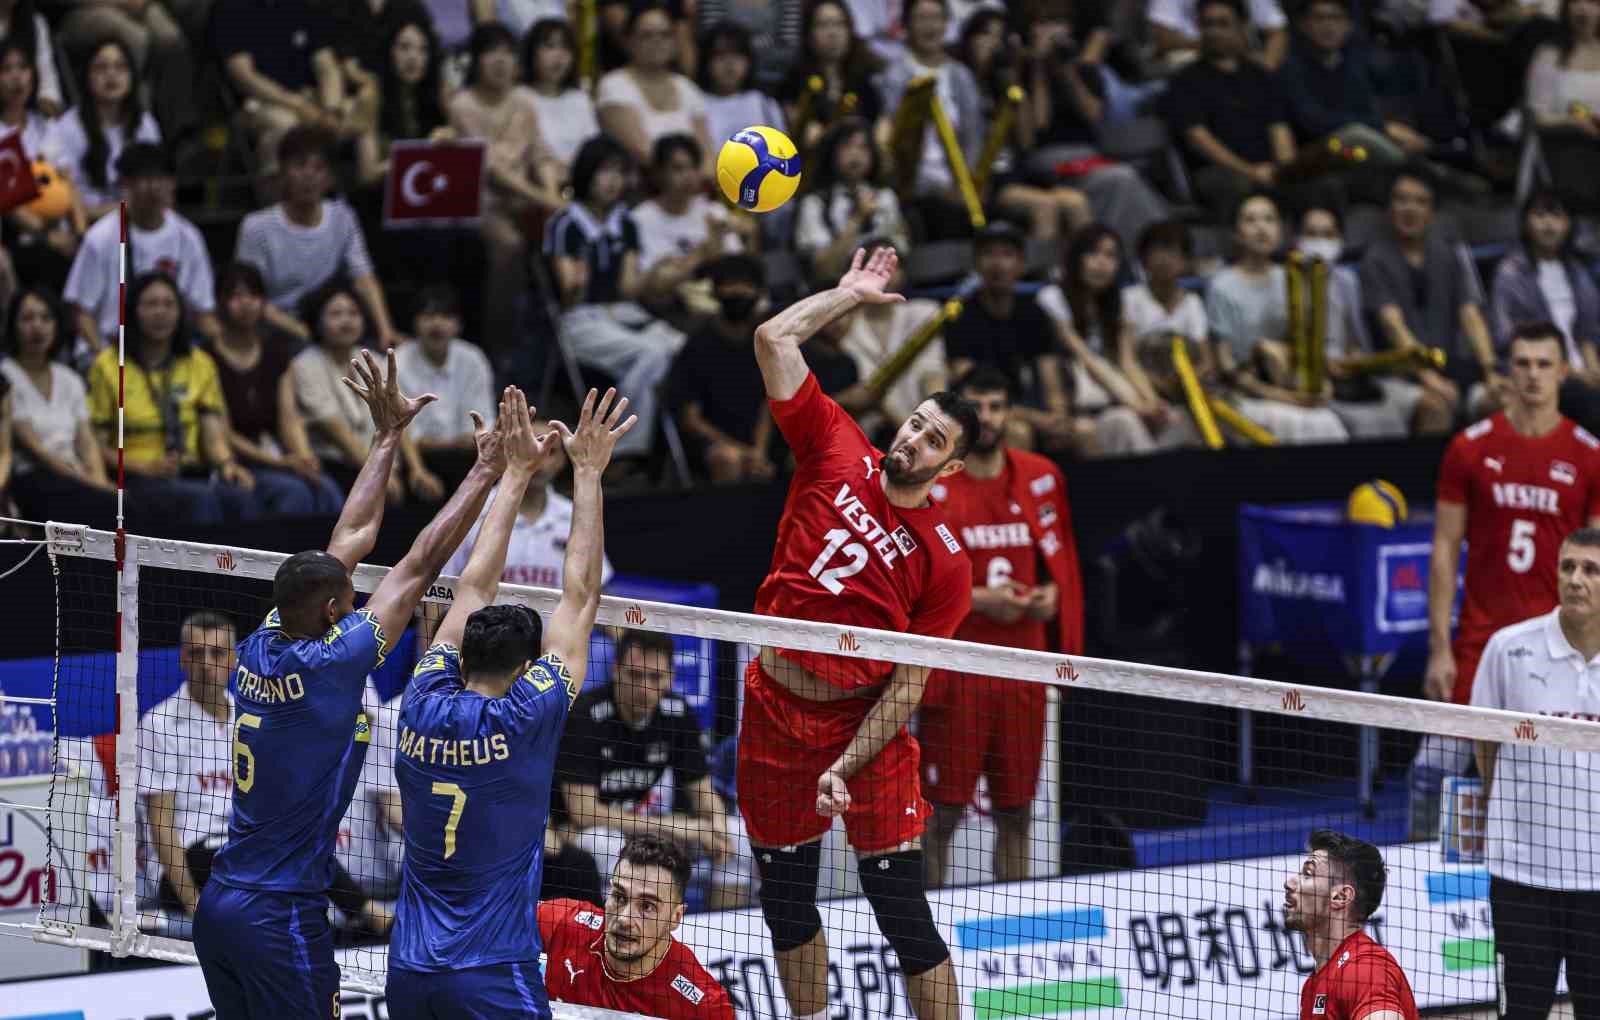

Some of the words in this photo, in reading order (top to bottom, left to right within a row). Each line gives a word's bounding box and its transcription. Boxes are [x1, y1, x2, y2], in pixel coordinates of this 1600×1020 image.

[808, 528, 869, 596] 12
[834, 483, 898, 570] VESTEL
[1508, 519, 1536, 574] 5
[232, 713, 262, 793] 6
[399, 726, 510, 766] MATHEUS
[431, 781, 466, 860] 7
[1129, 901, 1383, 990] 明和地
